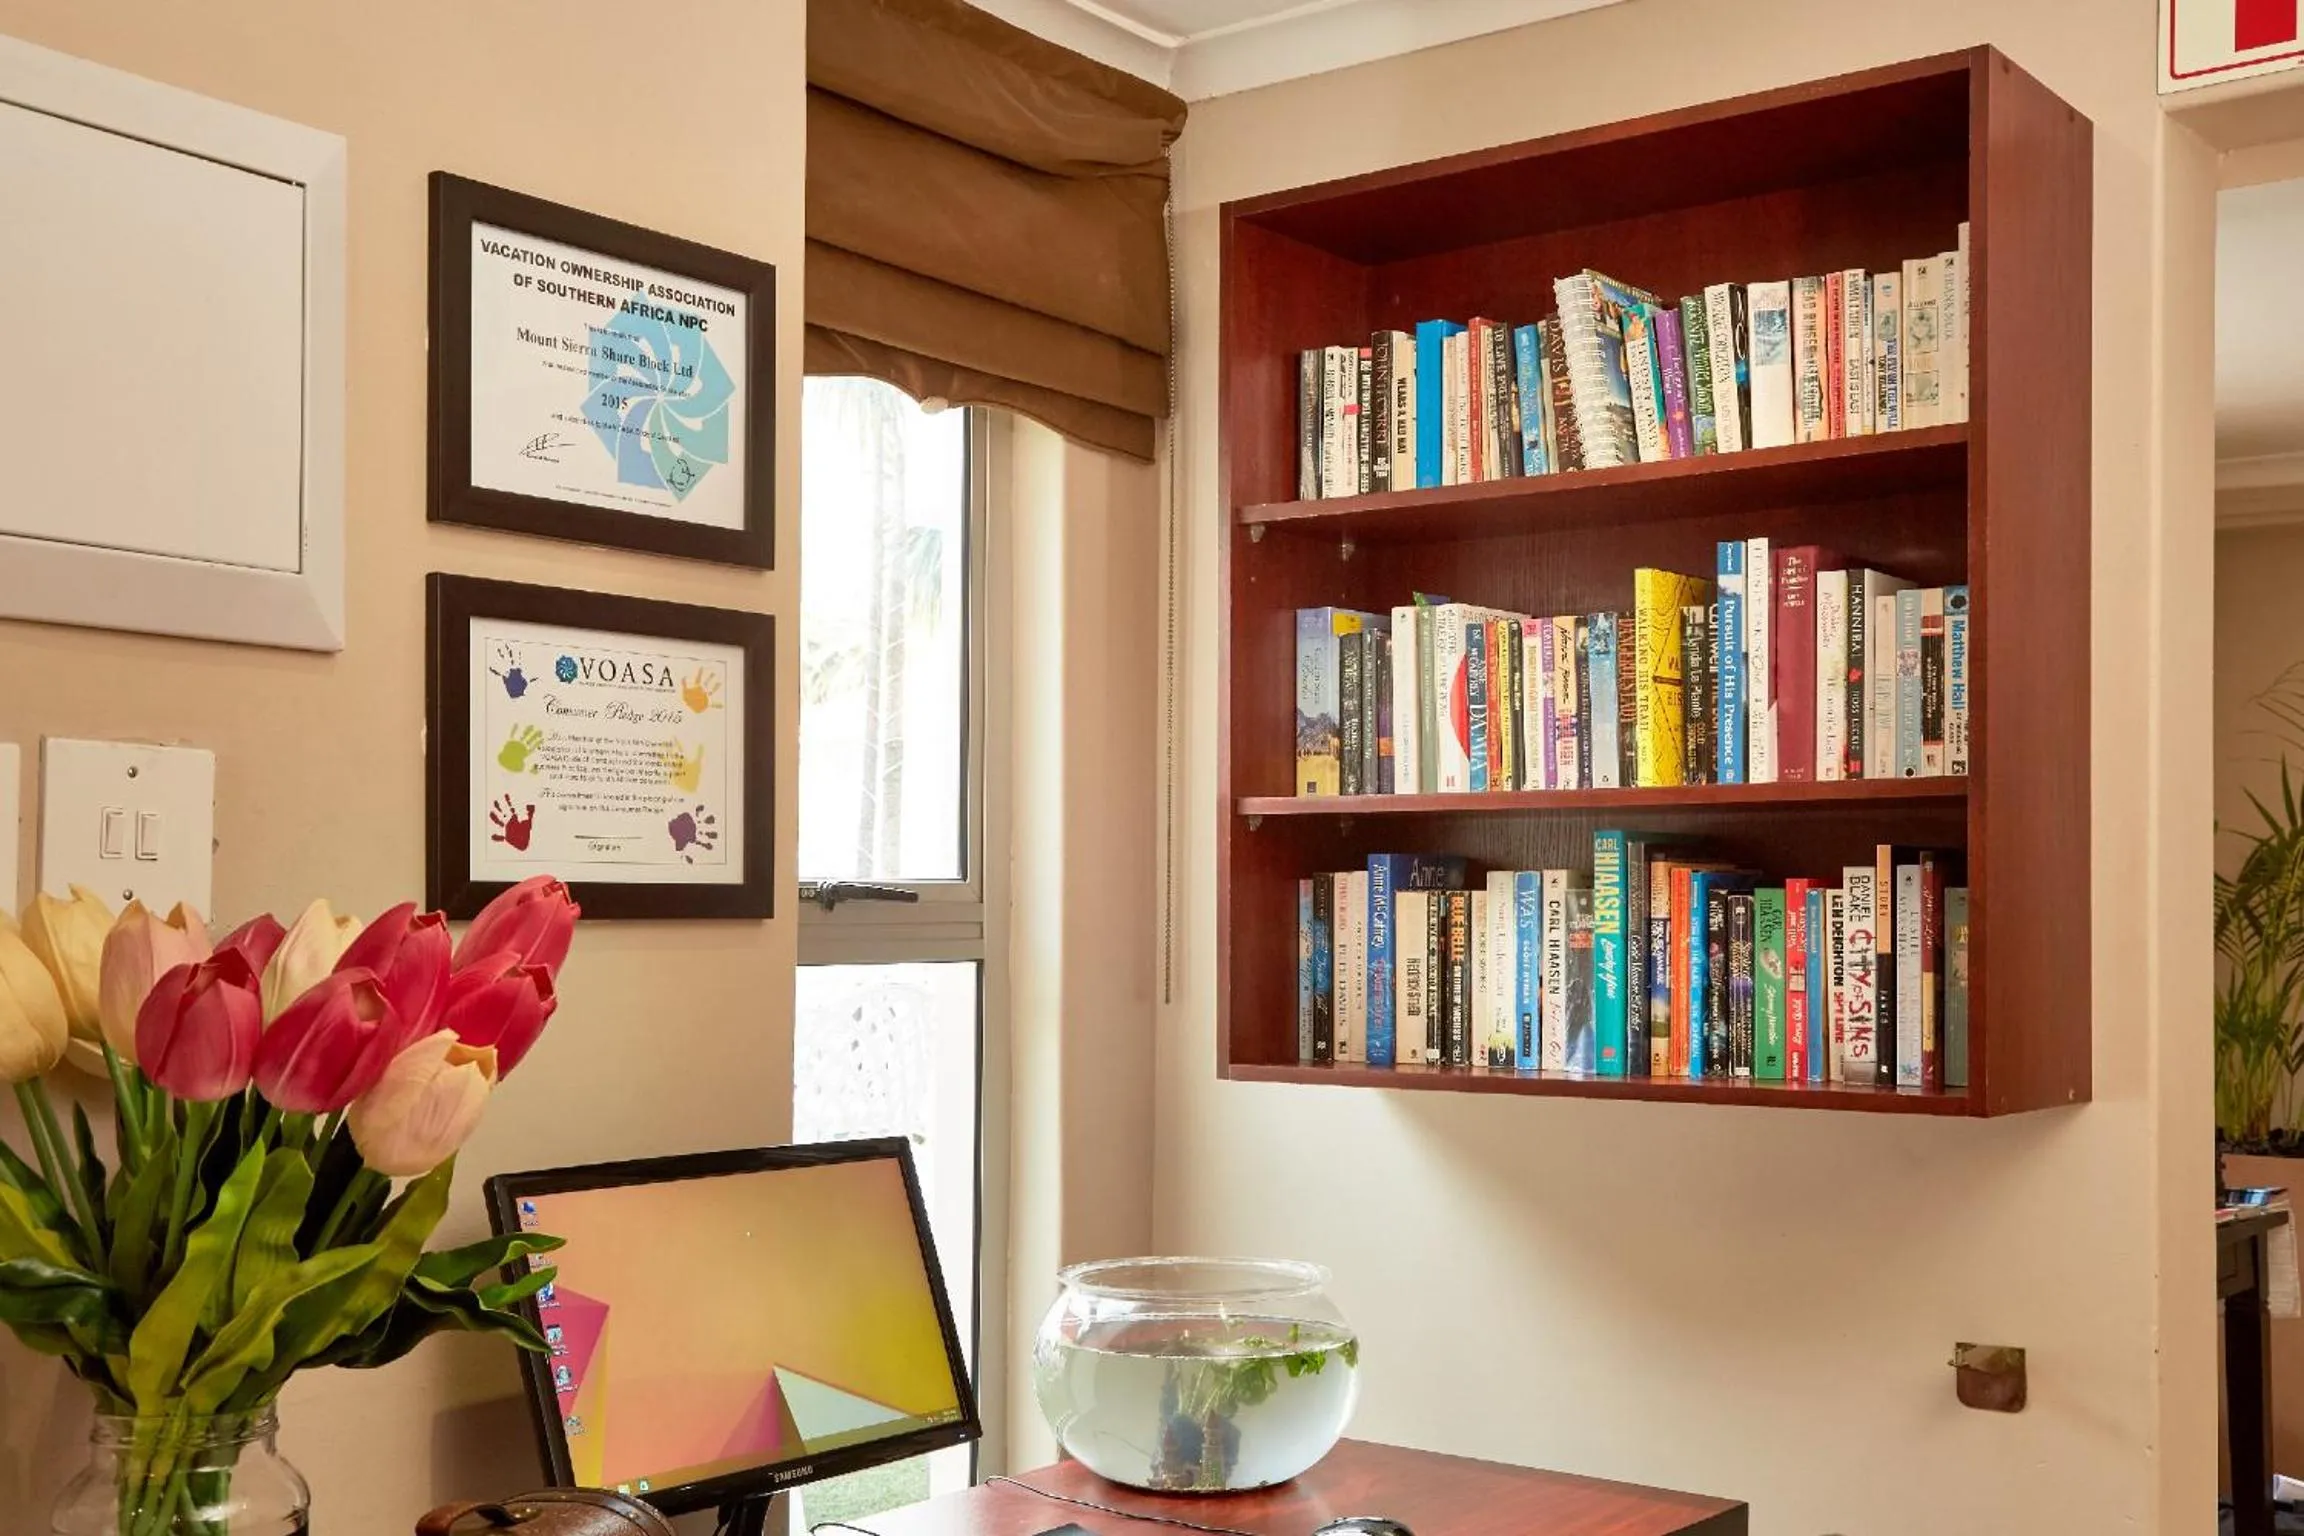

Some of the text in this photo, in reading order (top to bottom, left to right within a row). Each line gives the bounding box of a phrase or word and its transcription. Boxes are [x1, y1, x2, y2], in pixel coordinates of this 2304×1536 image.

[481, 238, 735, 317] VACATION OWNERSHIP ASSOCIATION
[513, 273, 708, 332] OF SOUTHERN AFRICA NPC
[517, 327, 692, 378] Mount Sierra Share Block Ltd
[1548, 319, 1566, 373] DAVIS
[1849, 358, 1860, 381] EAST
[601, 393, 628, 410] 2015
[1849, 393, 1860, 414] EAST
[1645, 407, 1658, 448] DAVIS
[580, 657, 675, 687] VOASA
[1638, 608, 1649, 731] WALKING HIS TRAIL
[1686, 634, 1704, 718] Lynda La Plante
[1723, 600, 1737, 765] Pursuit of His Presence
[1951, 620, 1966, 710] Matthew Hall
[543, 693, 684, 724] Consumer Pledge 2015
[1469, 703, 1488, 771] DAMIA
[1595, 838, 1619, 850] CARL
[1373, 864, 1388, 893] Anne
[1594, 852, 1620, 934] HIAASEN
[1849, 876, 1861, 922] BLAKE
[1861, 875, 1871, 922] DANIEL
[1879, 880, 1889, 917] STORY
[1451, 896, 1465, 926] BLUE
[1519, 889, 1536, 929] WAS
[1549, 900, 1561, 933] CARL
[1709, 900, 1719, 931] NIVEN
[1760, 899, 1773, 943] HIAASEN
[1772, 908, 1782, 931] CARL
[1451, 927, 1465, 960] BELLE
[1549, 939, 1561, 995] HIAASEN
[1832, 895, 1844, 1044] LEN DEIGHTON SPY LINE
